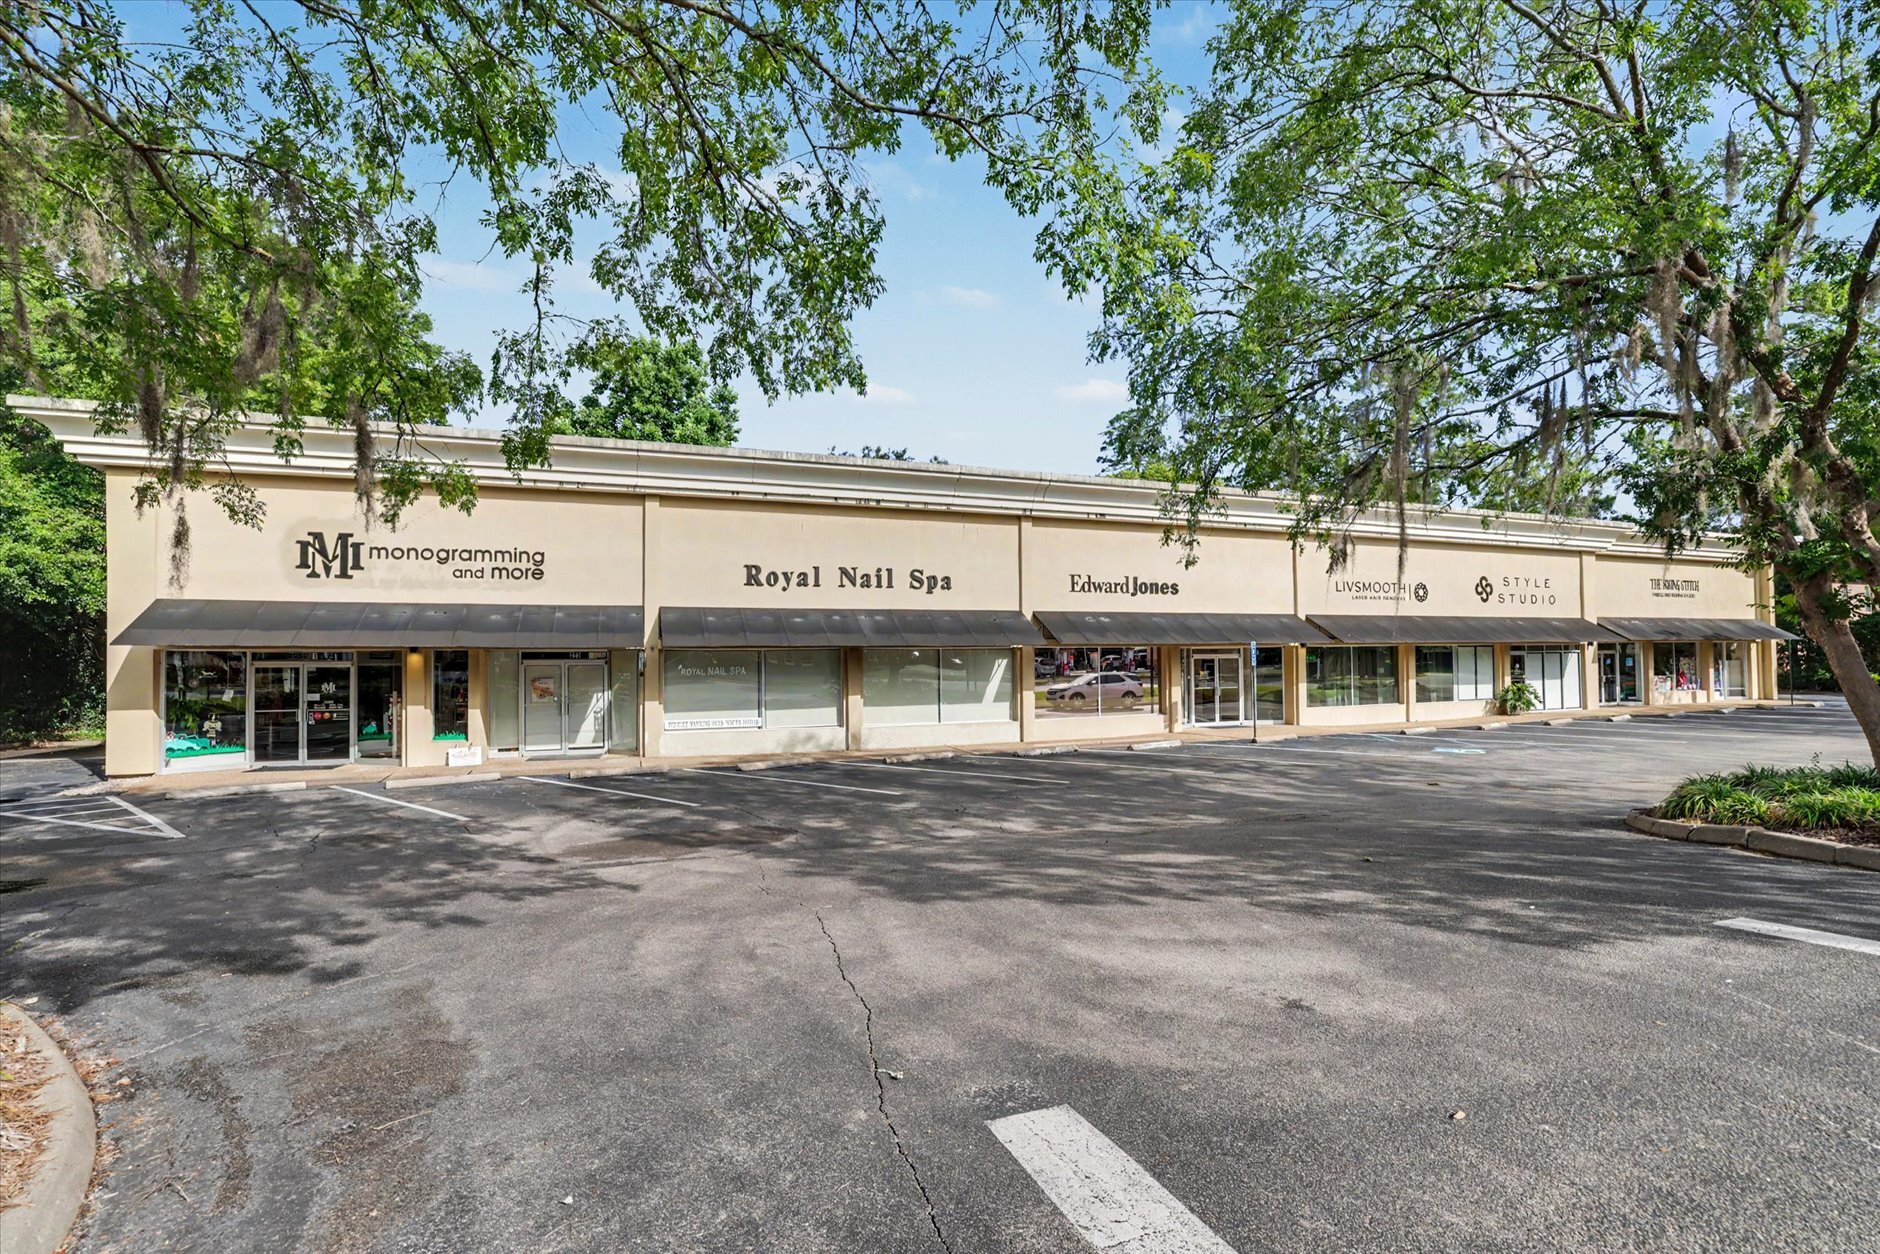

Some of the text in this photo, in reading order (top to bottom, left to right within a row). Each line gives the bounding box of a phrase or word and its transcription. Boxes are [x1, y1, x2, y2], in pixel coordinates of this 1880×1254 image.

[368, 545, 545, 567] monogramming
[452, 566, 545, 581] and more
[743, 564, 953, 594] Royal Nail Spa
[1335, 580, 1406, 594] LIVSMOOTH
[1502, 576, 1551, 589] STYLE
[1497, 593, 1556, 605] STUDIO
[681, 666, 747, 676] ROYAL NAIL SPA
